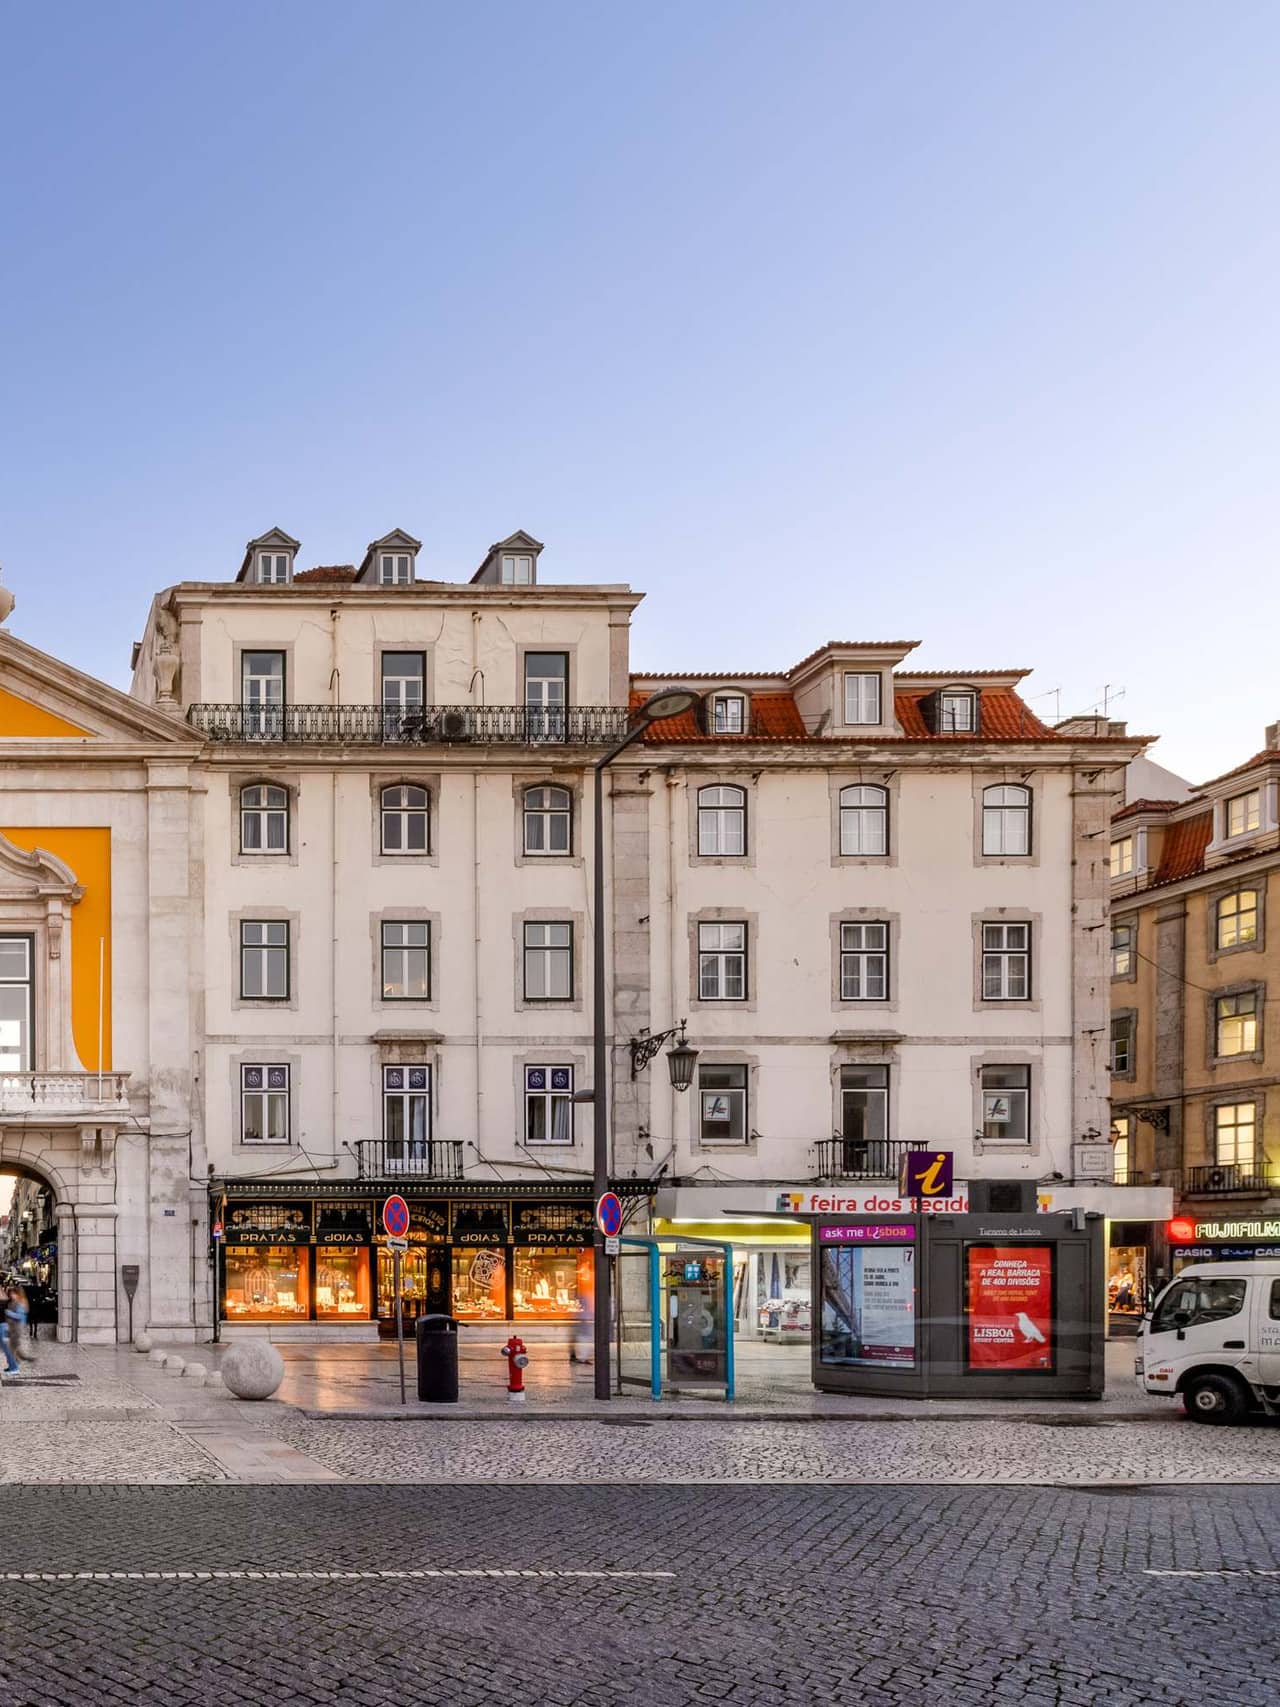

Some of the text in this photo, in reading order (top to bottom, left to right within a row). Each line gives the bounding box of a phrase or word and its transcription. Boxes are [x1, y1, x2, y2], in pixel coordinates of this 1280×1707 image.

[810, 1195, 857, 1211] feira
[864, 1195, 902, 1211] dos
[825, 1229, 843, 1238] ask
[847, 1228, 864, 1237] me
[1195, 1221, 1280, 1238] FUJIFILM
[240, 1233, 296, 1242] PRATAS
[528, 1233, 584, 1242] PRATAS
[905, 1250, 913, 1262] 7
[1175, 1248, 1213, 1257] CASIO
[974, 1329, 1014, 1338] LISBOA
